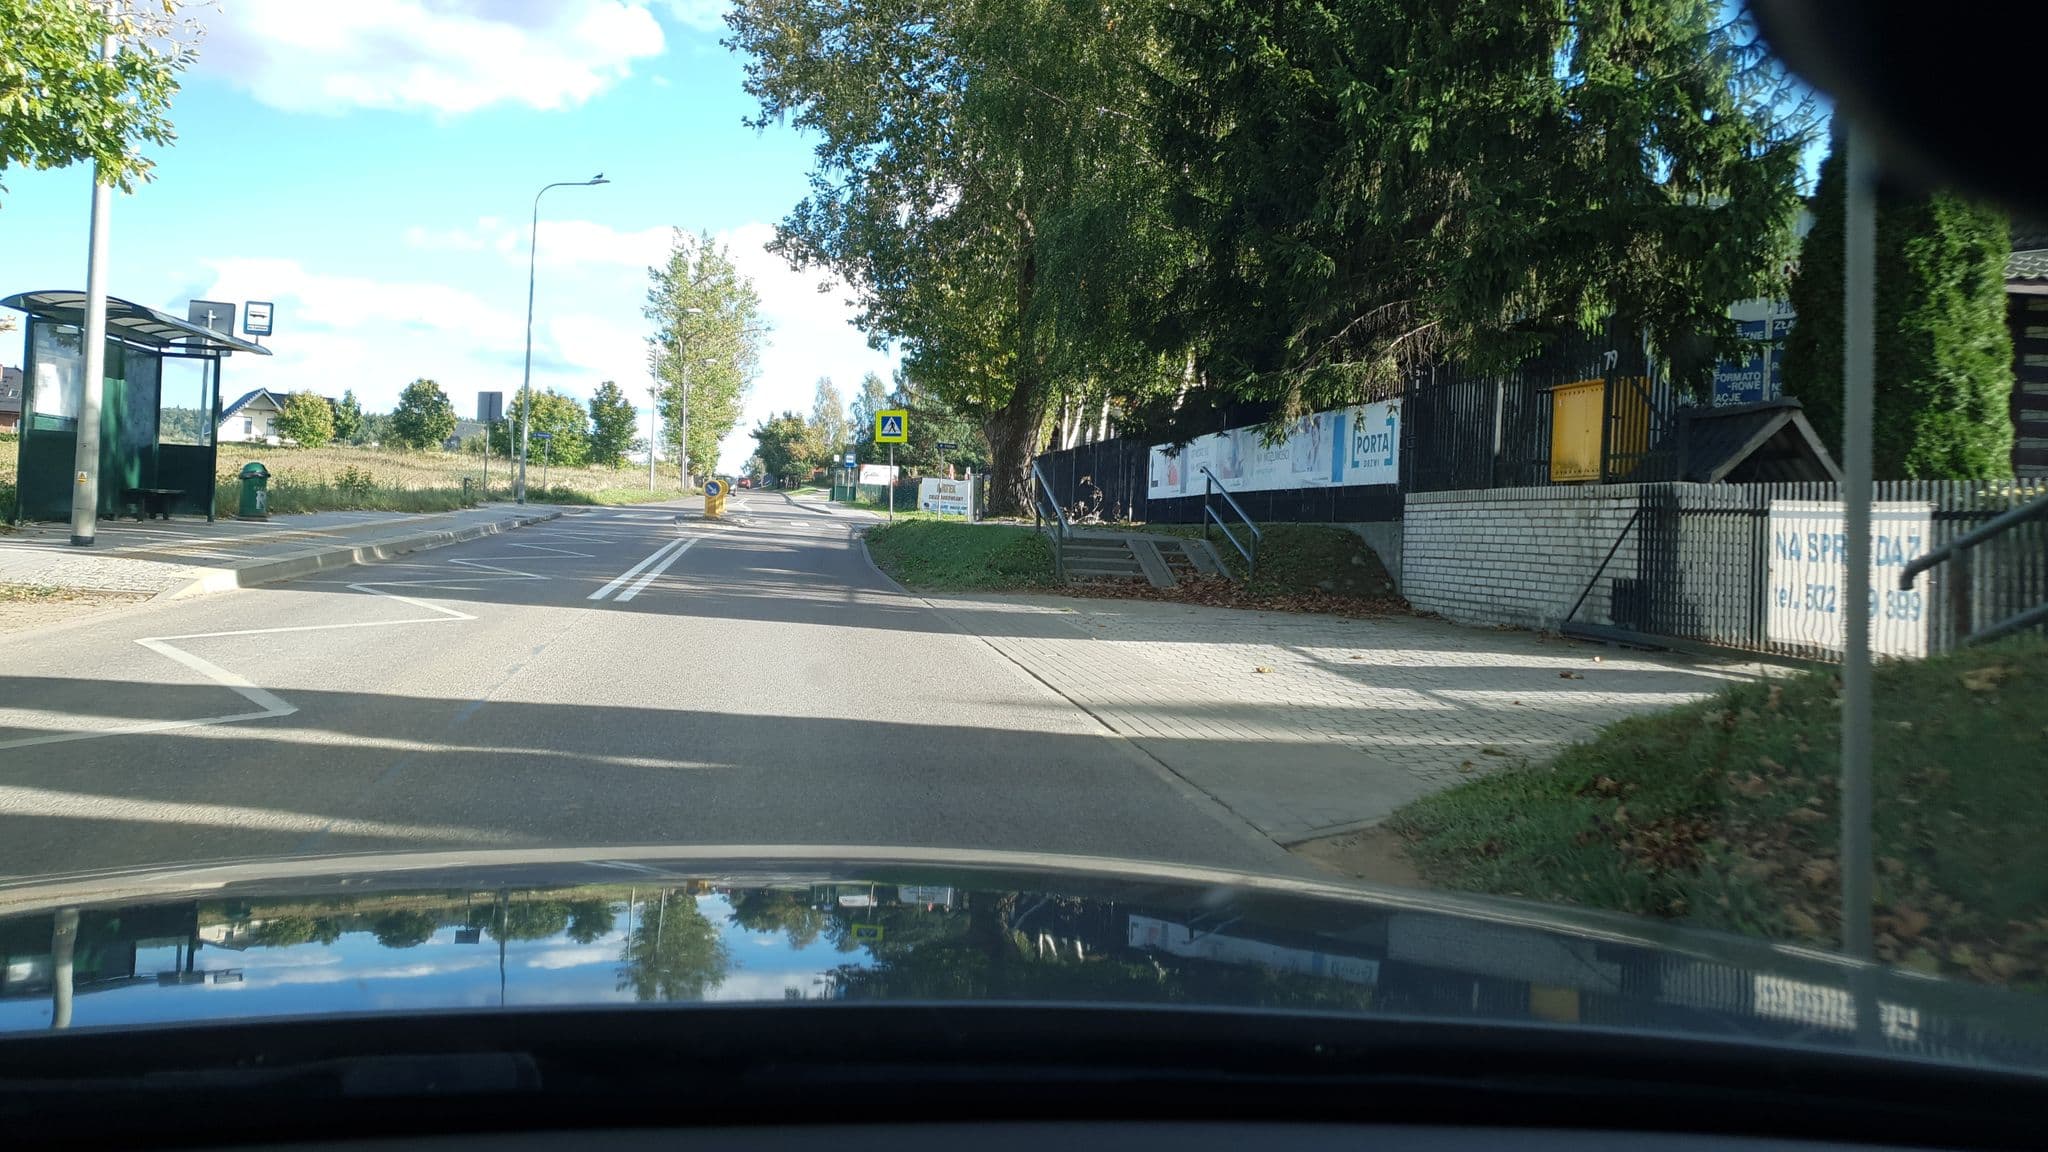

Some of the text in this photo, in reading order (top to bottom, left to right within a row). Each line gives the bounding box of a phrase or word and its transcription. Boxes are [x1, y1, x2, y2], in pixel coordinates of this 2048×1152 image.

[1714, 372, 1761, 382] FORMATO
[1357, 433, 1389, 454] PORTA
[1775, 527, 1921, 568] NA SPRDAŻ
[1806, 583, 1837, 613] 502
